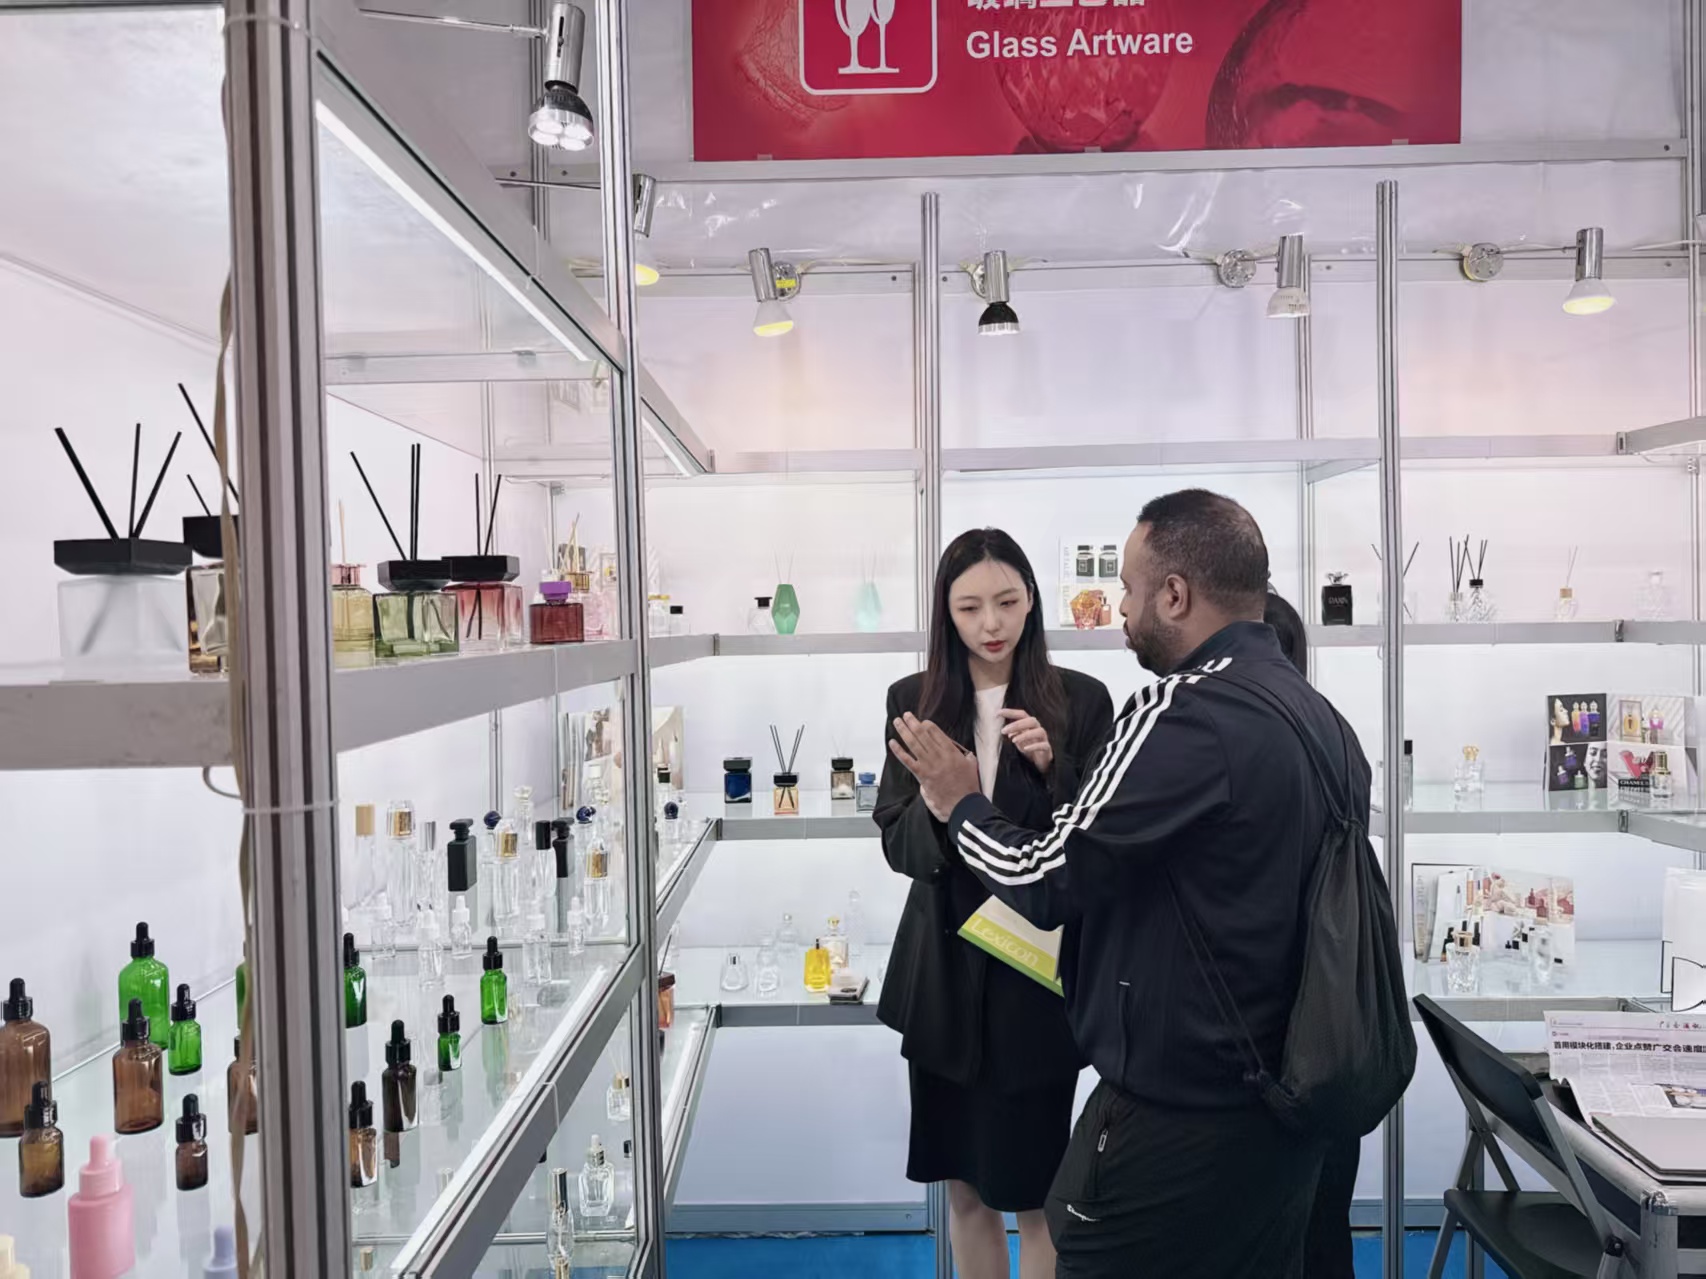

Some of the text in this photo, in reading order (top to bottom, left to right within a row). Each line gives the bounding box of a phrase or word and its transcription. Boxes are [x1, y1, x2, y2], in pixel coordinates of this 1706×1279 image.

[966, 28, 1194, 59] Glass Artware
[969, 918, 1039, 967] Lexicon
